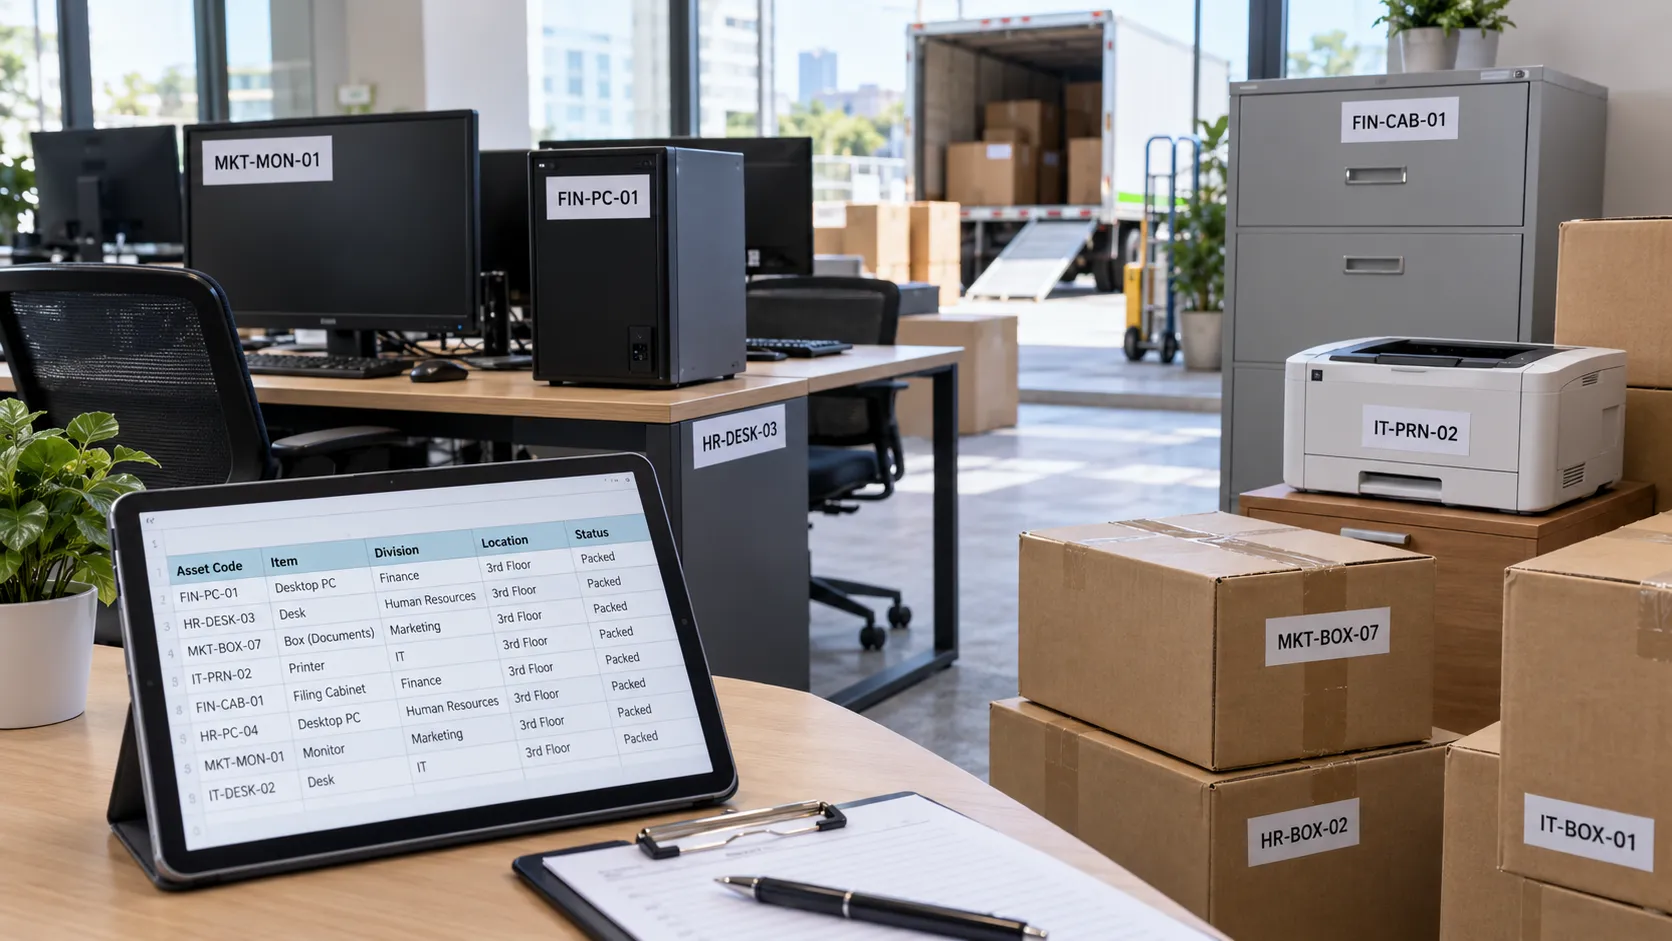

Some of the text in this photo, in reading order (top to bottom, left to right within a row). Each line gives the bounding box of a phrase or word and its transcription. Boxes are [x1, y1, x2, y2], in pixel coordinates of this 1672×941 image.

[1353, 112, 1445, 130] FIN-CAB-01
[215, 152, 319, 170] MKT-MON-01
[559, 190, 637, 206] FIN-PC-01
[703, 421, 777, 452] HR-DESK-03
[1375, 420, 1457, 441] IT-PRN-02
[575, 529, 609, 539] Status
[482, 536, 528, 548] Location
[375, 545, 419, 558] Division
[581, 551, 615, 563] Packed
[177, 561, 242, 576] Asset Code
[271, 558, 298, 567] Item
[487, 561, 531, 573] 3rd Floor
[380, 573, 419, 583] Finance
[587, 576, 621, 588] Packed
[275, 578, 336, 593] Desktop PC
[492, 586, 536, 598] 3rd Floor
[180, 588, 237, 602] FIN-PC-01
[385, 593, 476, 608] Human Resources
[280, 608, 306, 620] Desk
[594, 601, 627, 613] Packed
[184, 613, 255, 629] HR-DESK-03
[497, 611, 542, 624] 3rd Floor
[390, 622, 441, 635] Marketing
[599, 626, 633, 639] Packed
[284, 627, 374, 646] Box (Documents)
[503, 637, 547, 650] 3rd Floor
[1279, 624, 1379, 650] MKT-BOX-07
[188, 639, 260, 656] MKT-BOX-07
[396, 651, 404, 661] IT
[606, 652, 640, 664] Packed
[289, 662, 324, 673] Printer
[509, 664, 553, 676] 3rd Floor
[192, 668, 252, 684] IT-PRN-02
[401, 677, 441, 688] Finance
[612, 678, 646, 691] Packed
[293, 684, 366, 702] Filing Cabinet
[514, 690, 559, 703] 3rd Floor
[196, 695, 263, 713] FIN-CAB-01
[406, 698, 499, 716] Human Resources
[618, 704, 652, 717] Packed
[298, 712, 361, 729] Desktop PC
[520, 717, 564, 730] 3rd Floor
[200, 725, 258, 742] HR-PC-04
[412, 729, 463, 744] Marketing
[624, 730, 658, 744] Packed
[303, 745, 344, 758] Monitor
[526, 744, 570, 758] 3rd Floor
[205, 751, 284, 771] MKT-MON-01
[417, 761, 426, 772] IT
[308, 774, 335, 788] Desk
[209, 782, 275, 801] IT-DESK-02
[1261, 816, 1348, 850] HR-BOX-02
[1540, 813, 1636, 851] IT-BOX-01
